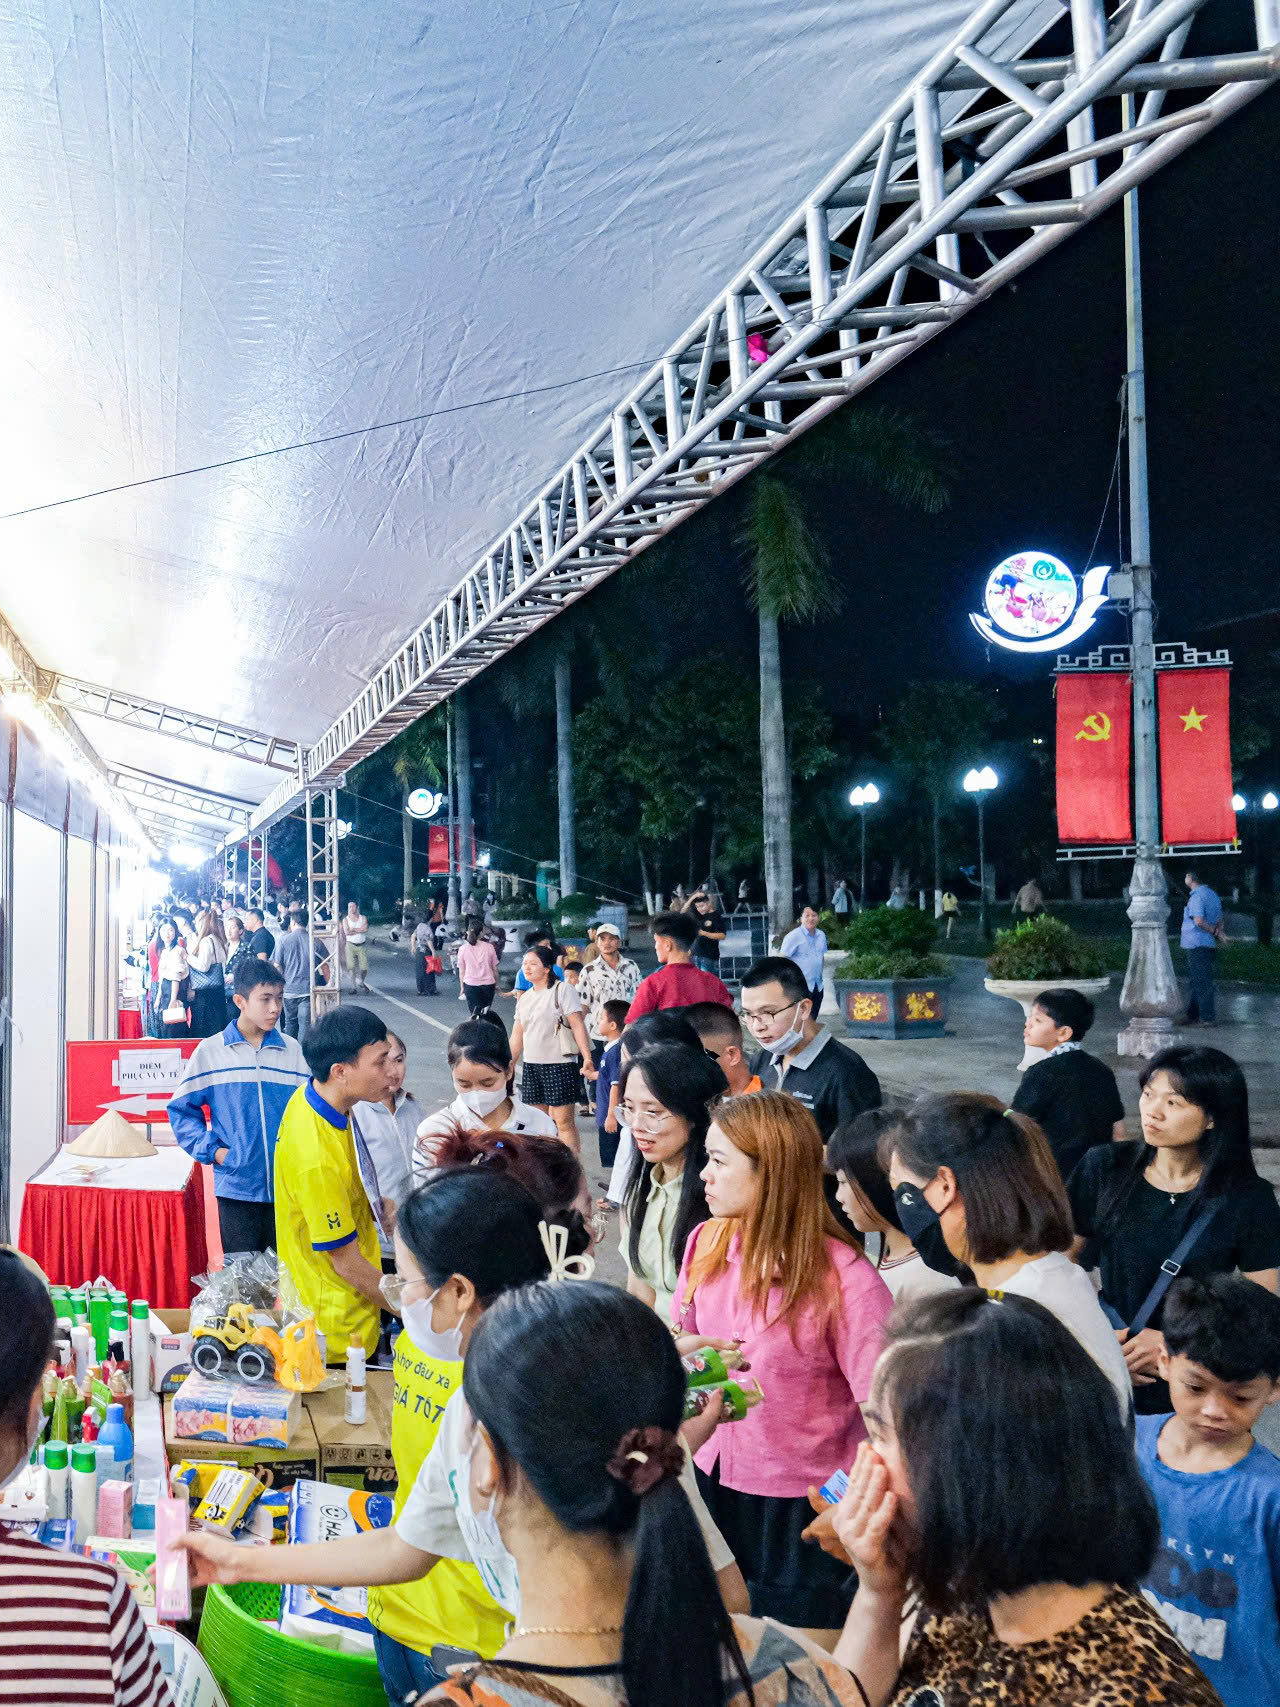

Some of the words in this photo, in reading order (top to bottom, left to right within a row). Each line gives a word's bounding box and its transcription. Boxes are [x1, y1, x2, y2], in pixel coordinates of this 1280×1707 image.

[122, 1072, 144, 1081] PHỤC
[436, 1374, 450, 1390] xa
[393, 1383, 410, 1409] GIÁ
[414, 1394, 446, 1424] TỐT
[326, 1520, 342, 1542] HA
